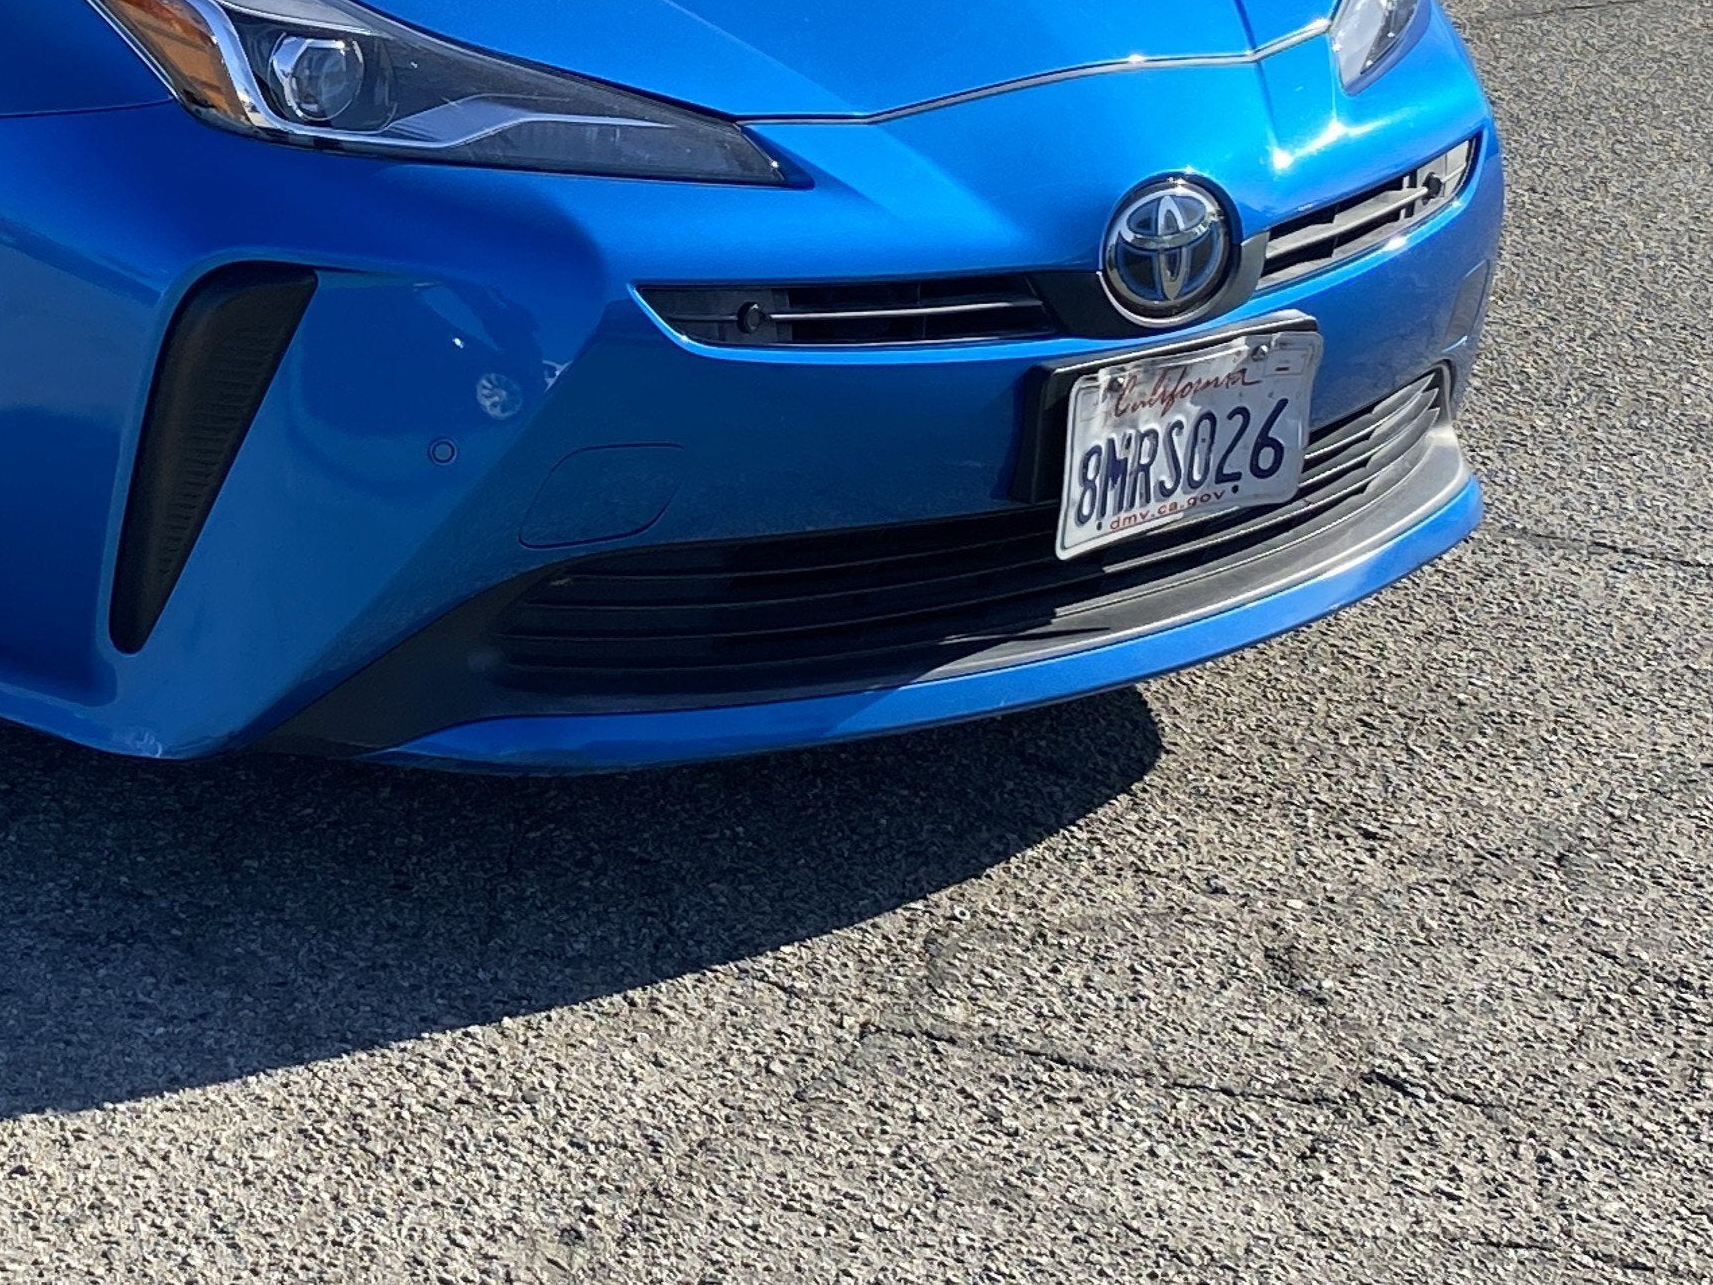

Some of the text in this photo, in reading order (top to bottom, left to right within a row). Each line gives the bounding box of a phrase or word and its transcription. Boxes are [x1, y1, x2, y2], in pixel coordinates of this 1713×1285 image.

[1113, 366, 1262, 417] California
[1075, 398, 1289, 527] 8MRS026
[1109, 488, 1226, 531] dmv.ca.gov
